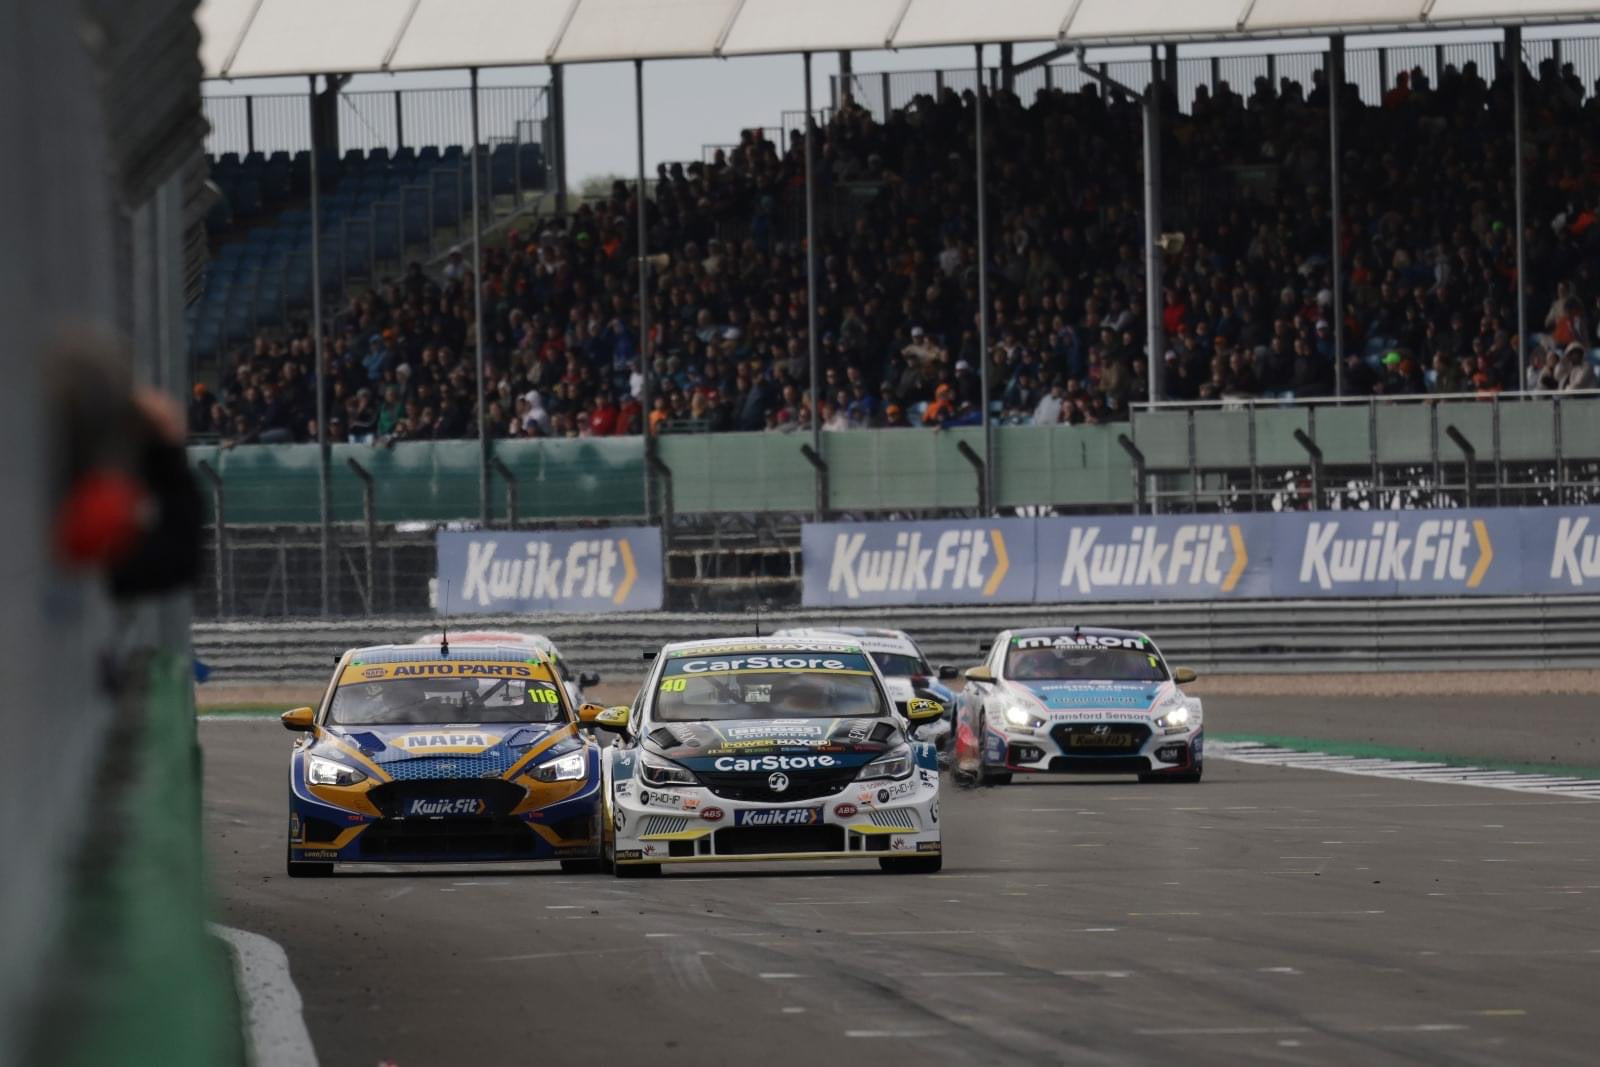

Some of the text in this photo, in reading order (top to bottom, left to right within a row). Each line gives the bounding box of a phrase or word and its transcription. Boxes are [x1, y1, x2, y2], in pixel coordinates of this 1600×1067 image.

[682, 656, 845, 673] CarStore
[1148, 655, 1157, 667] 1
[393, 664, 454, 676] AUTO
[458, 664, 531, 676] PARTS
[660, 678, 687, 692] 40
[528, 689, 558, 704] 116
[1050, 711, 1151, 721] Hansford Sensors
[408, 735, 485, 747] NAPA
[714, 755, 835, 771] CarStore
[703, 810, 721, 818] ABS
